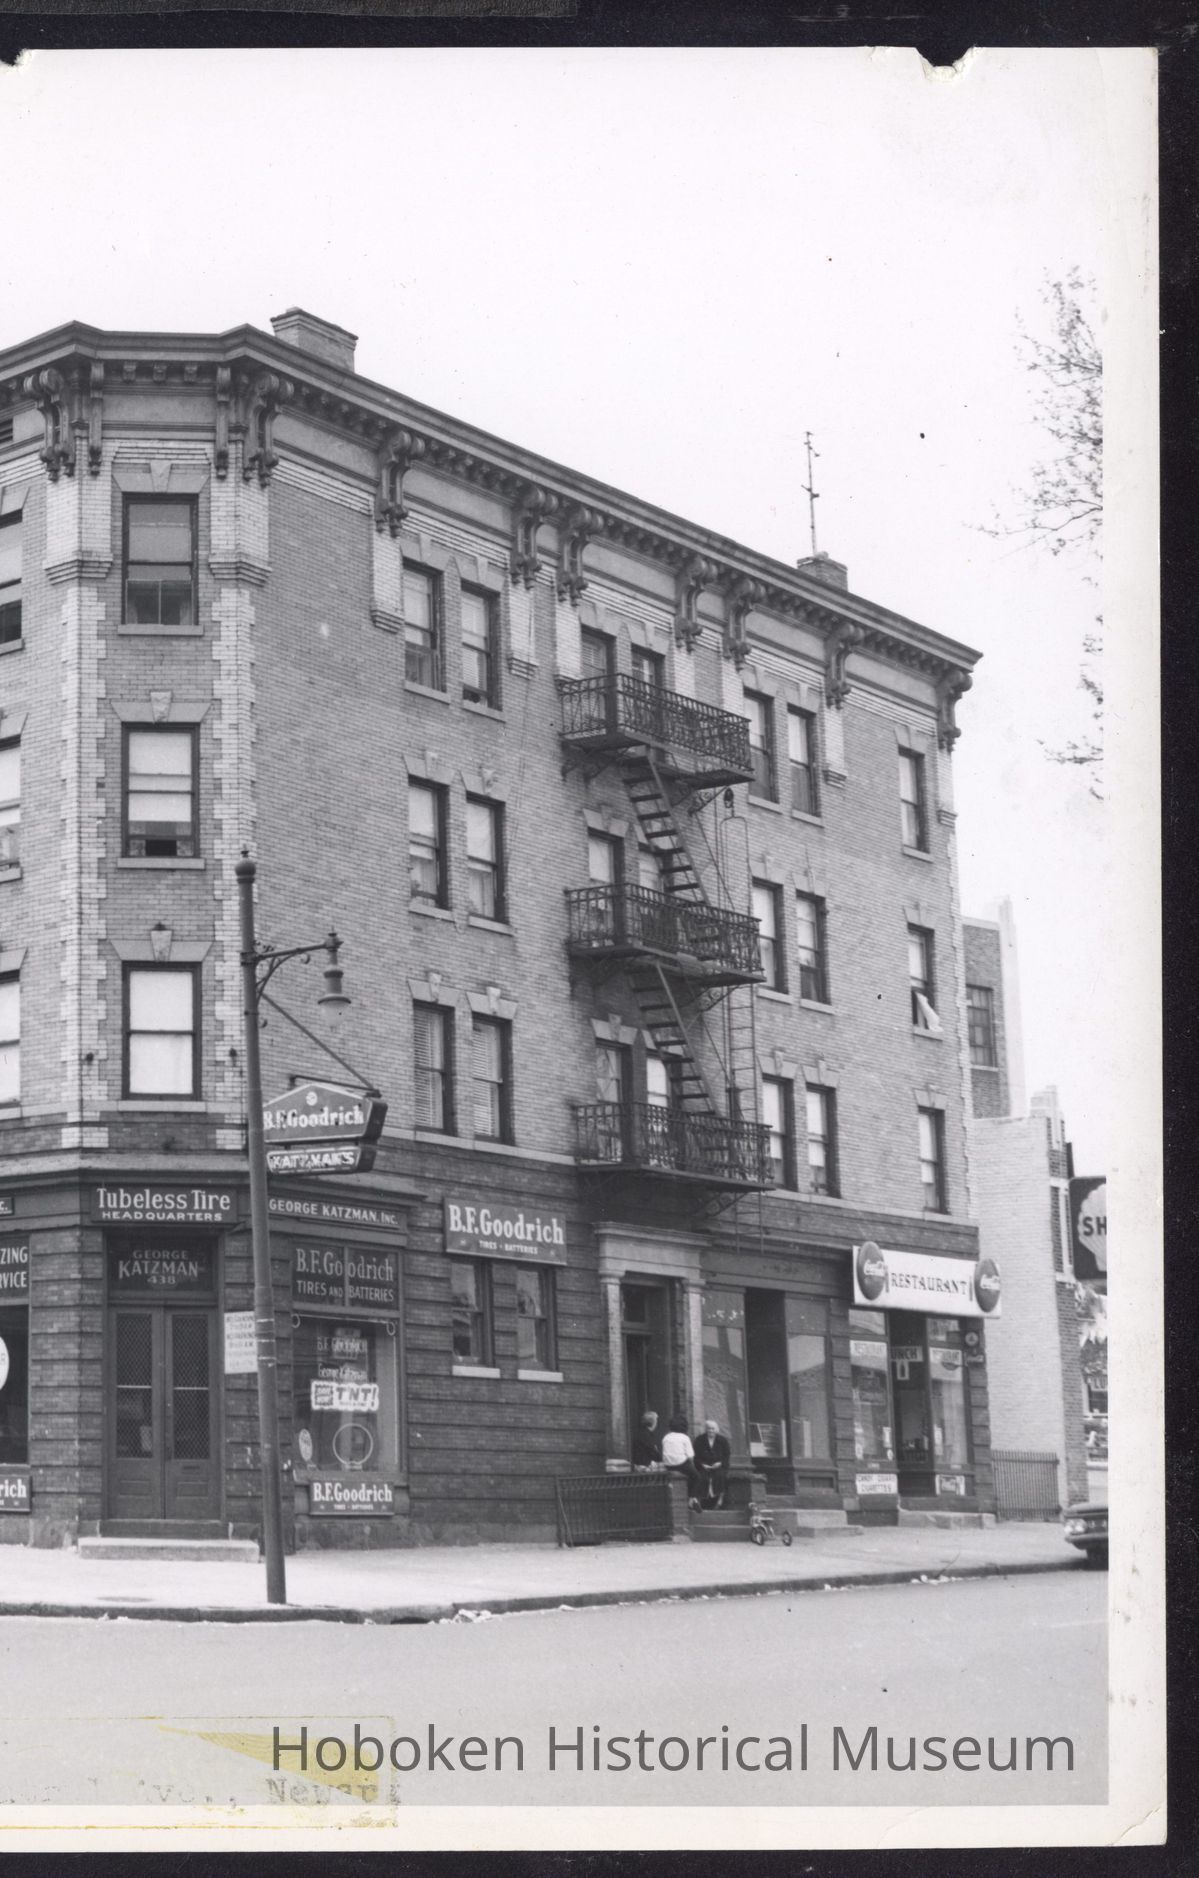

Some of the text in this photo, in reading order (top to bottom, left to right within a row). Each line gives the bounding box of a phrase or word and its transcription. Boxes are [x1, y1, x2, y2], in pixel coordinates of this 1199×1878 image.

[97, 1187, 230, 1210] Tubeless Tire
[269, 1198, 318, 1215] GEORGE
[102, 1211, 223, 1221] HEADQUARTERS
[132, 1250, 188, 1260] GEORGE
[119, 1260, 198, 1279] KATZMAN
[147, 1275, 176, 1284] 438
[891, 1272, 968, 1295] RESTAURANT
[297, 1280, 394, 1302] TIRES AND BATTERIES
